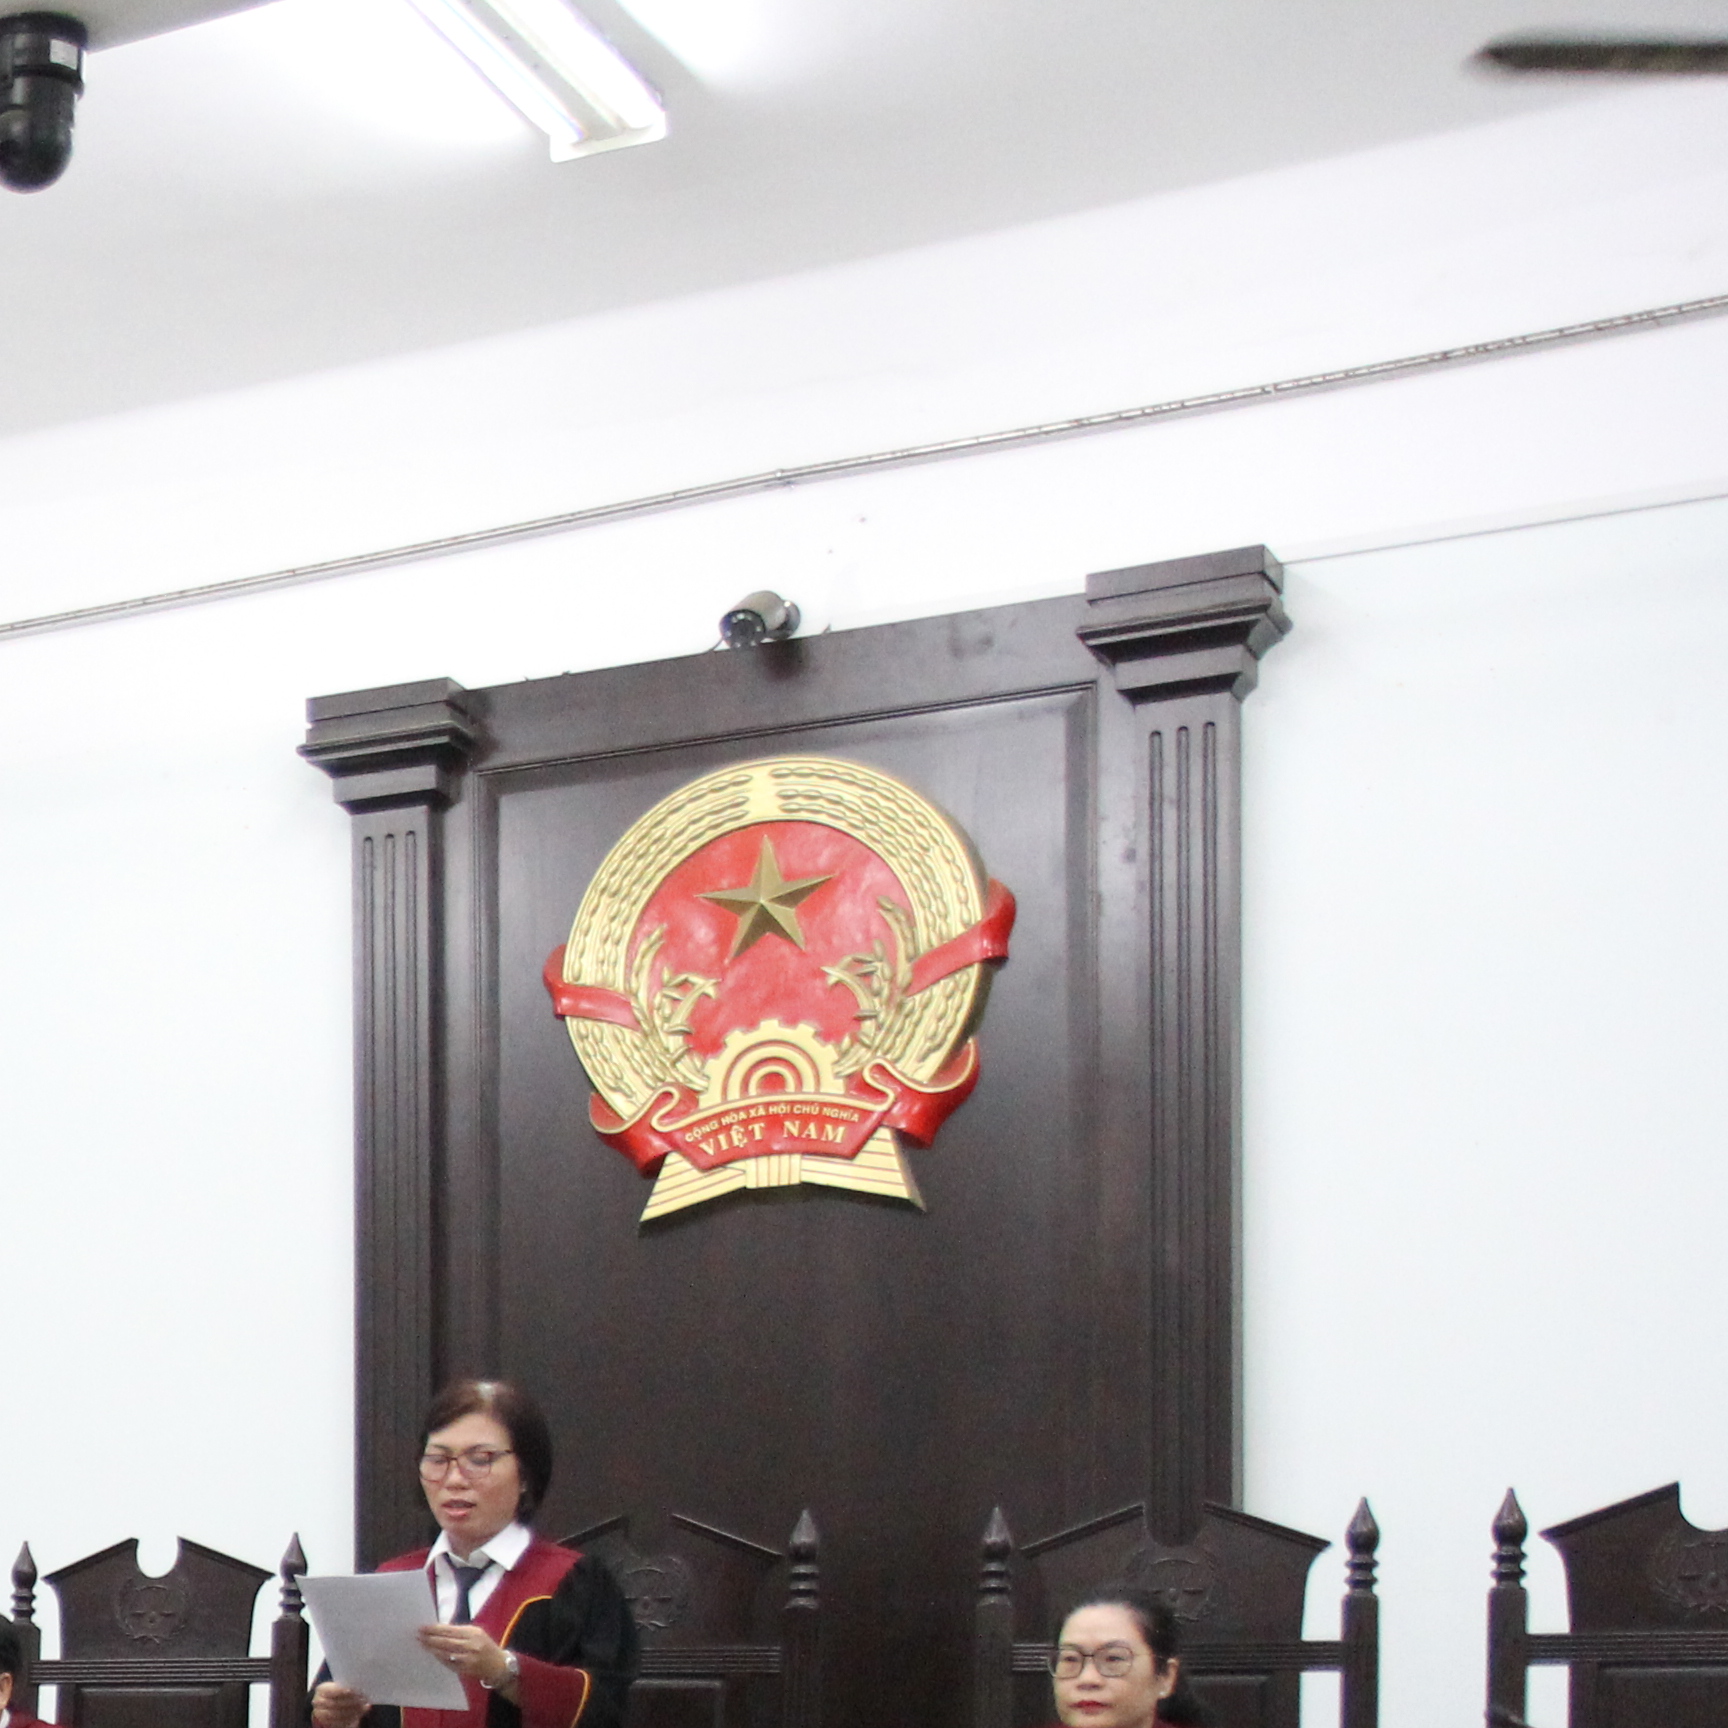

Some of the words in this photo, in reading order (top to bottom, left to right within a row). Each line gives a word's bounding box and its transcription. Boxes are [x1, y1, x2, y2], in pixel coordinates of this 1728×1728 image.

[685, 1121, 719, 1142] CỘNG
[699, 1123, 765, 1156] VIỆT
[783, 1120, 845, 1144] NAM
